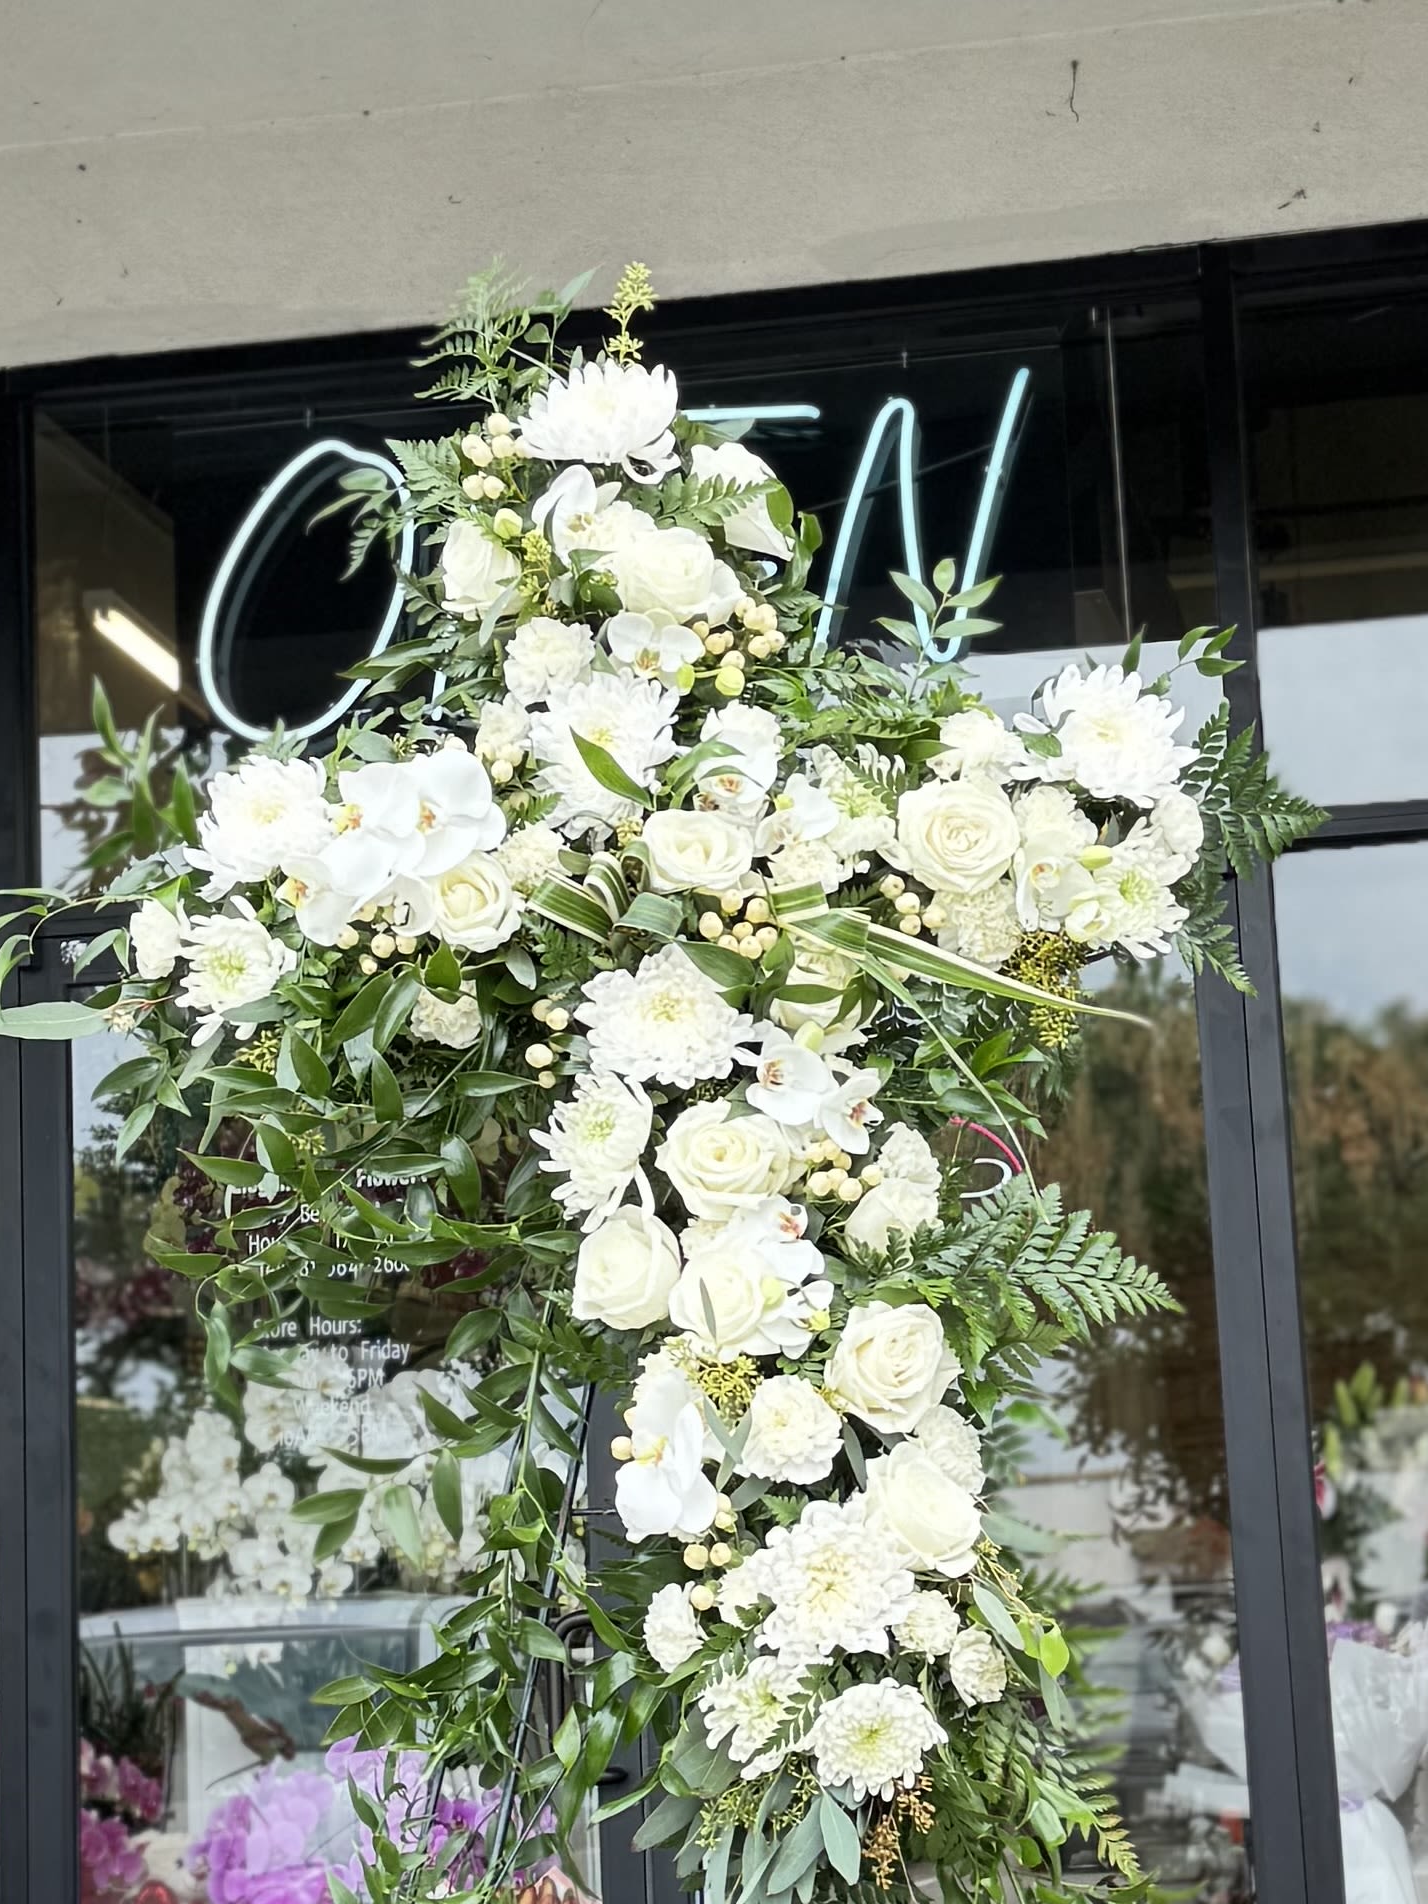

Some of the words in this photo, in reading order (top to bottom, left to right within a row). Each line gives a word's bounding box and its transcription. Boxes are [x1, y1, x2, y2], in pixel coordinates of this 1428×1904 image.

[198, 367, 1029, 742] ON
[309, 1315, 362, 1336] Hours:
[330, 1343, 349, 1362] to
[360, 1337, 411, 1364] Friday
